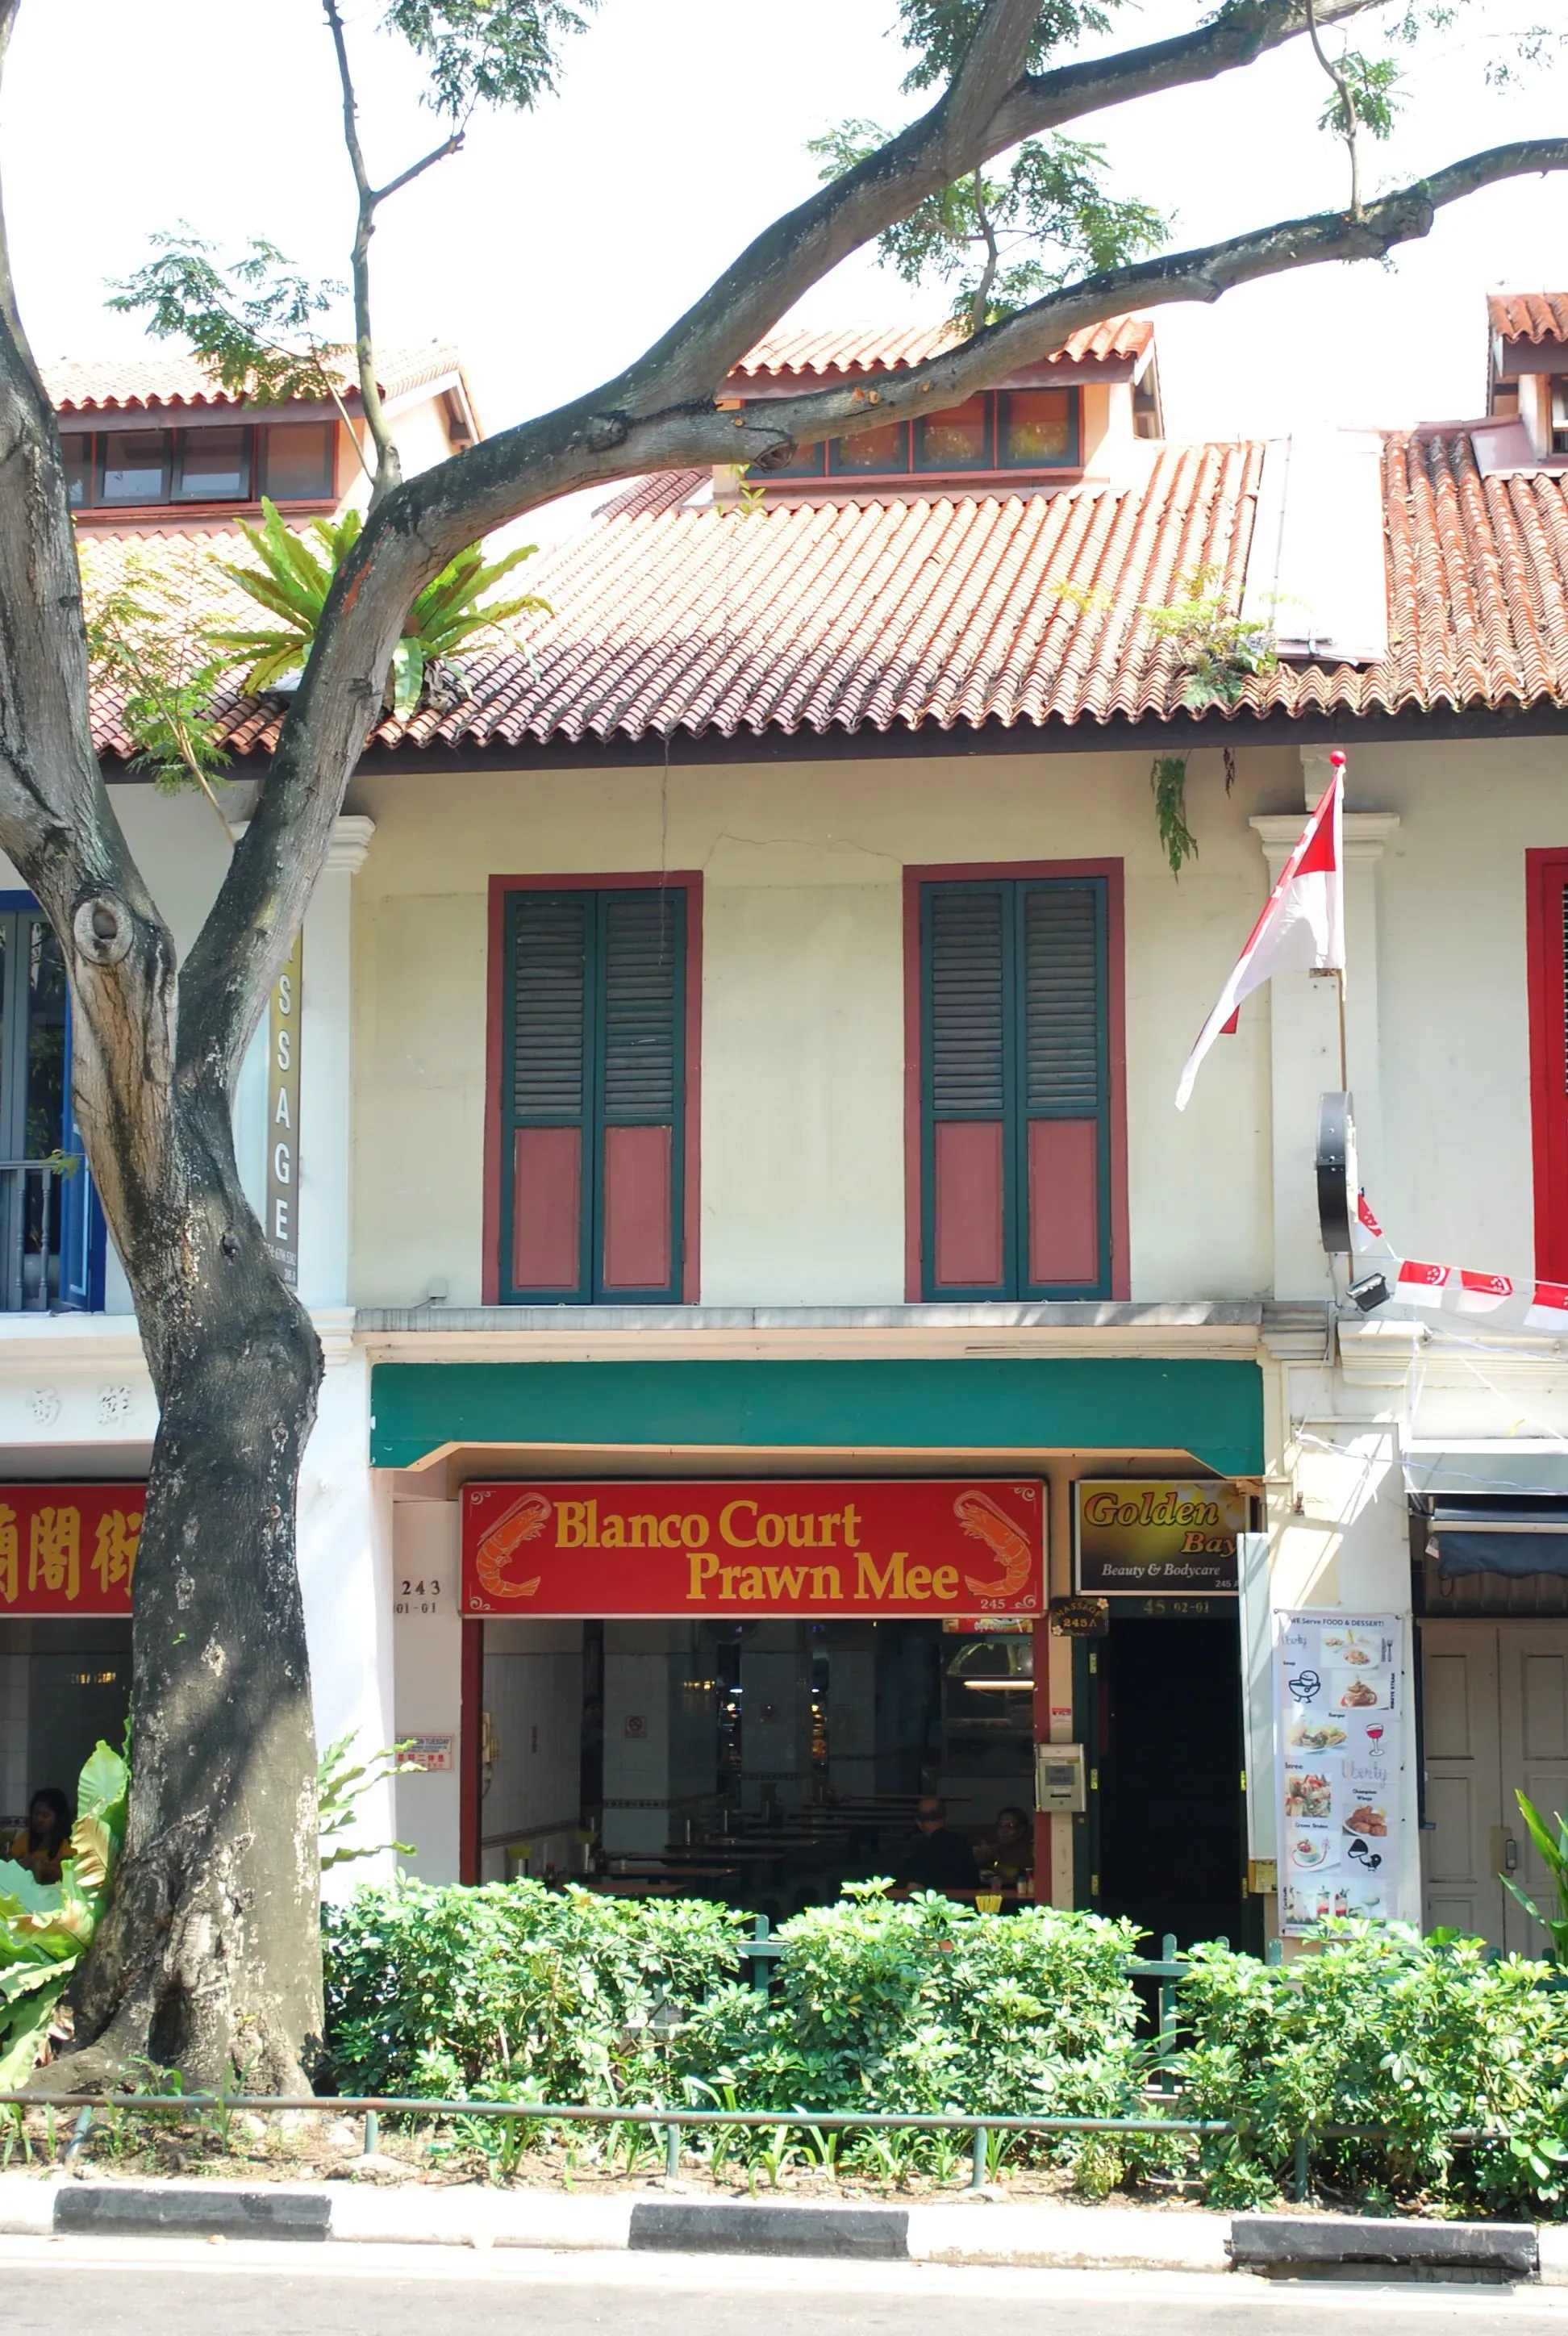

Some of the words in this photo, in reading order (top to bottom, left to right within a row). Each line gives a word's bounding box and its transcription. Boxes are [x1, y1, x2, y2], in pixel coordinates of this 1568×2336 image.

[1084, 1491, 1220, 1527] Golden
[553, 1499, 709, 1548] Blanco
[719, 1500, 861, 1548] Court
[686, 1552, 844, 1600] Prawn
[853, 1552, 959, 1600] Mee
[1101, 1563, 1145, 1578] Beauty
[1148, 1562, 1161, 1576] &
[1163, 1563, 1220, 1579] Bodycare
[402, 1579, 440, 1596] 243
[1215, 1579, 1232, 1588] 245
[394, 1602, 436, 1614] 01-01
[980, 1598, 1006, 1609] 245
[1323, 1618, 1343, 1626] FOOD
